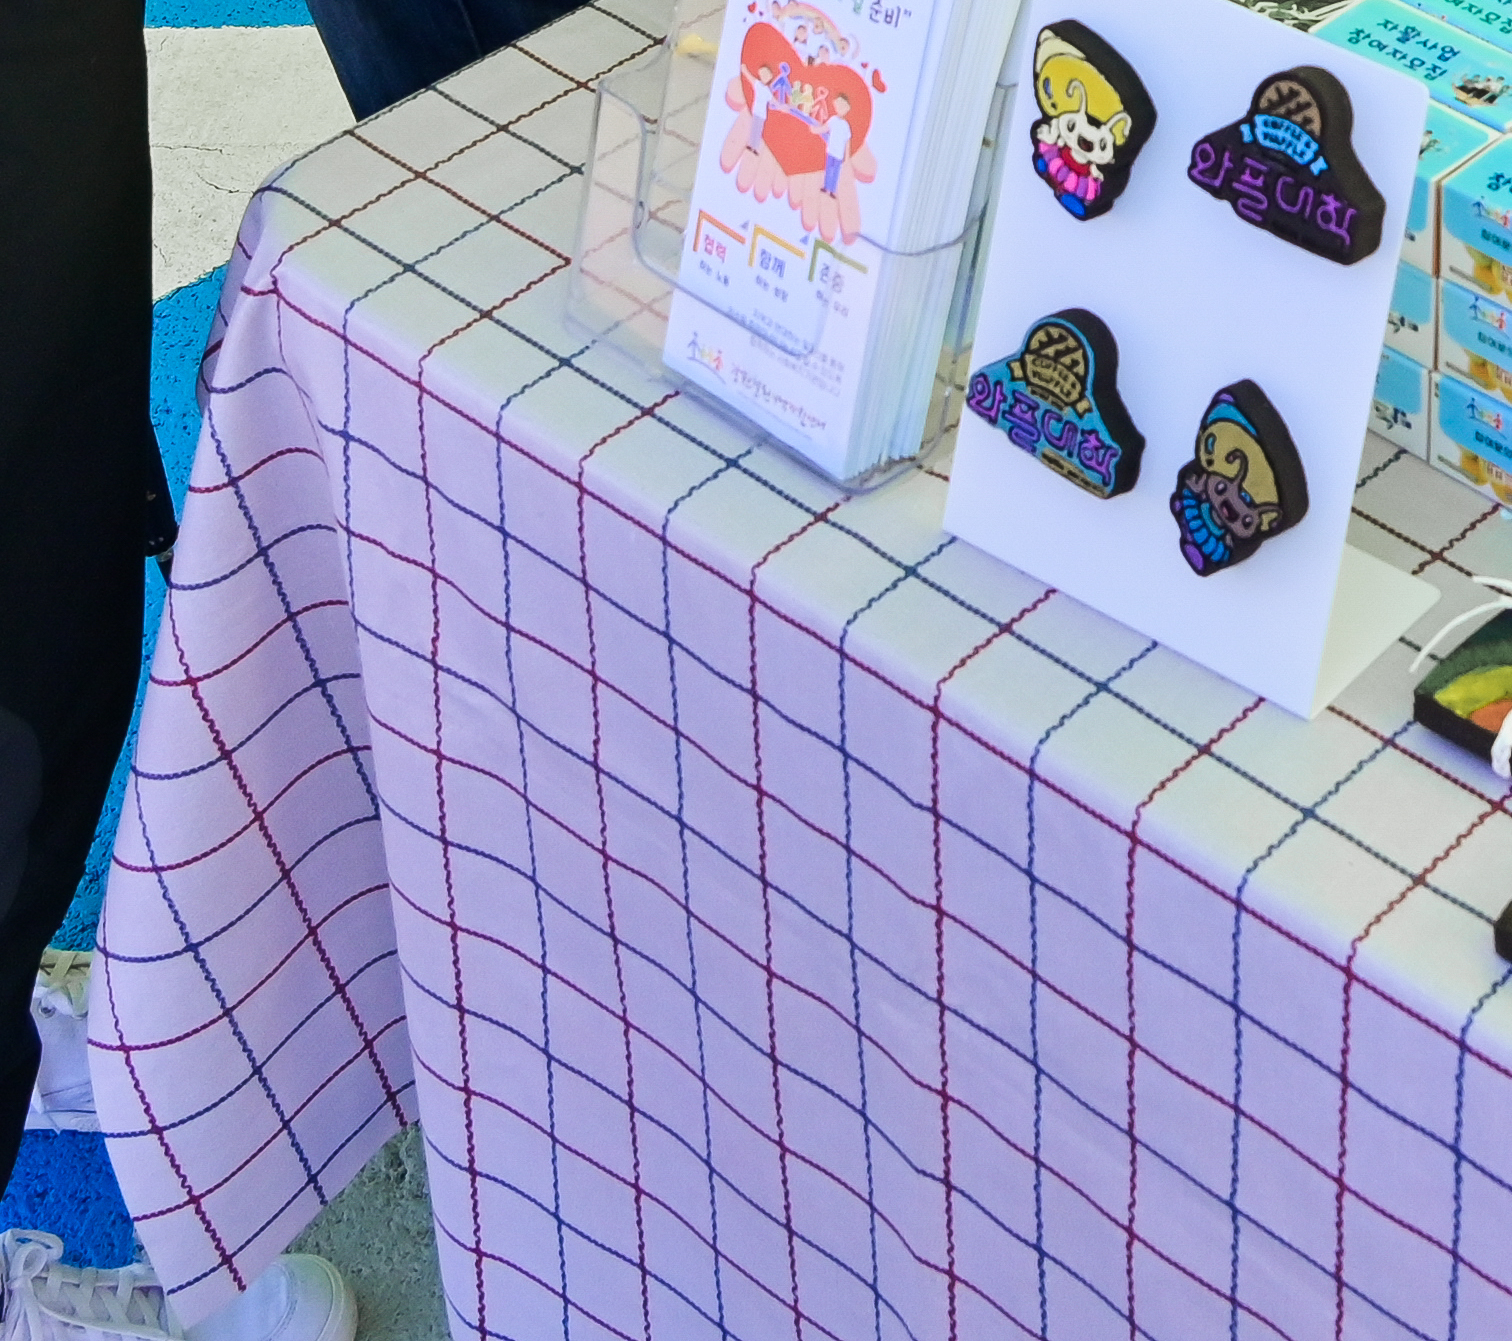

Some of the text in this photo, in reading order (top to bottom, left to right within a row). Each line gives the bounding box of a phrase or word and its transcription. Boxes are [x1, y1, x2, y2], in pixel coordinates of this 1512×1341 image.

[1377, 18, 1461, 62] 자활사업
[1190, 142, 1358, 247] 와플대학
[967, 372, 1123, 487] 와플대학
